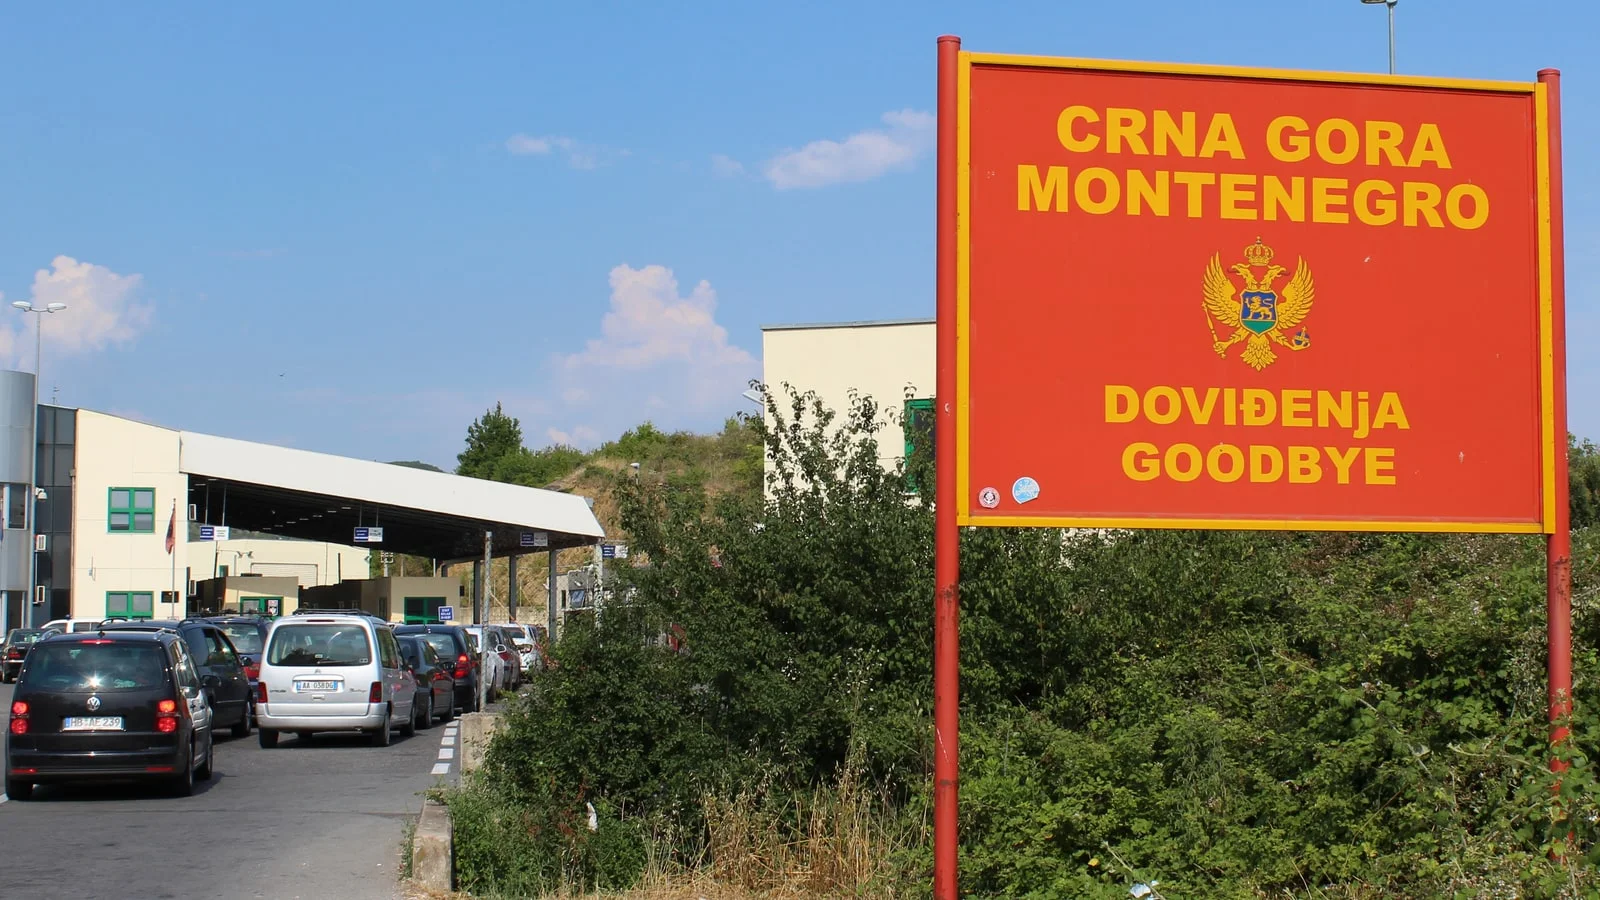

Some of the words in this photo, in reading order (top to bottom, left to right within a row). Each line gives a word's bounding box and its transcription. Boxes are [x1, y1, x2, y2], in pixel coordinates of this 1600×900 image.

[1056, 105, 1246, 161] CRNA
[1266, 115, 1452, 170] GORA
[1017, 164, 1490, 230] MONTENEGRO
[1104, 384, 1410, 440] DOVIĐENjA
[1121, 441, 1397, 486] GOODBYE
[103, 716, 121, 728] 239
